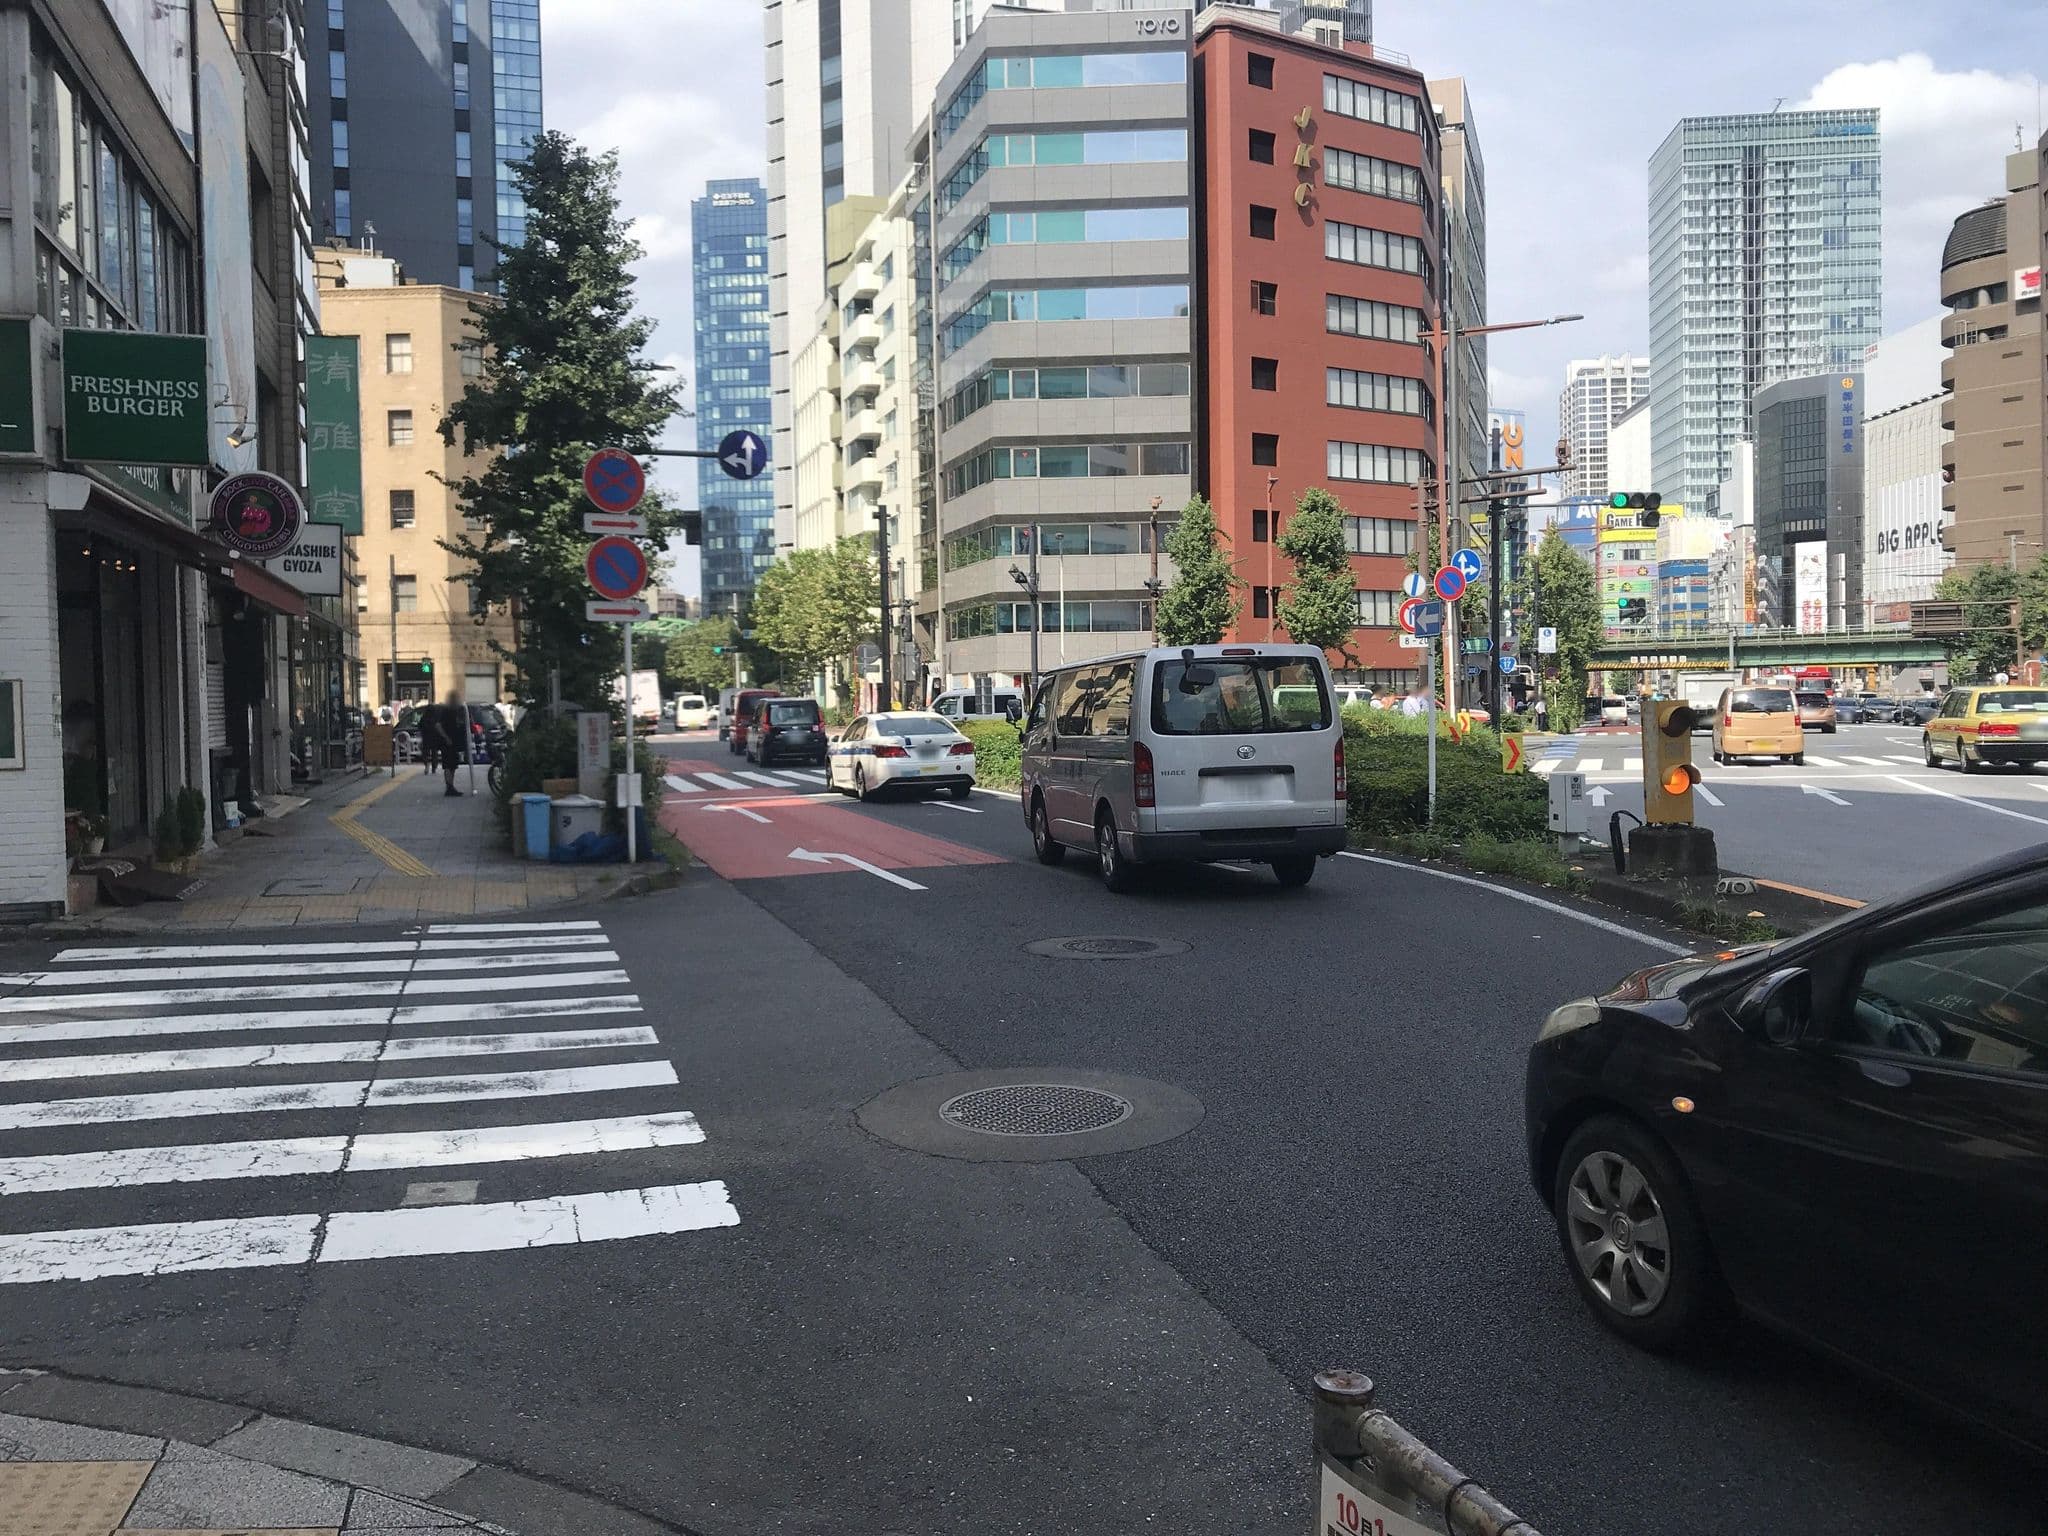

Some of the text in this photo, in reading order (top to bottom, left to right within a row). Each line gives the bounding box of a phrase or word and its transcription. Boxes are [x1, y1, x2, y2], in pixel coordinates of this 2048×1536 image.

[1135, 18, 1180, 36] TOYO
[70, 375, 199, 399] FRESHNESS
[88, 396, 184, 417] BURGER
[308, 351, 360, 518] 清雅堂
[1607, 513, 1632, 528] GAME
[1878, 519, 1943, 555] BIG APPLE
[283, 544, 337, 559] RASHIBE
[283, 559, 323, 573] GYOZA
